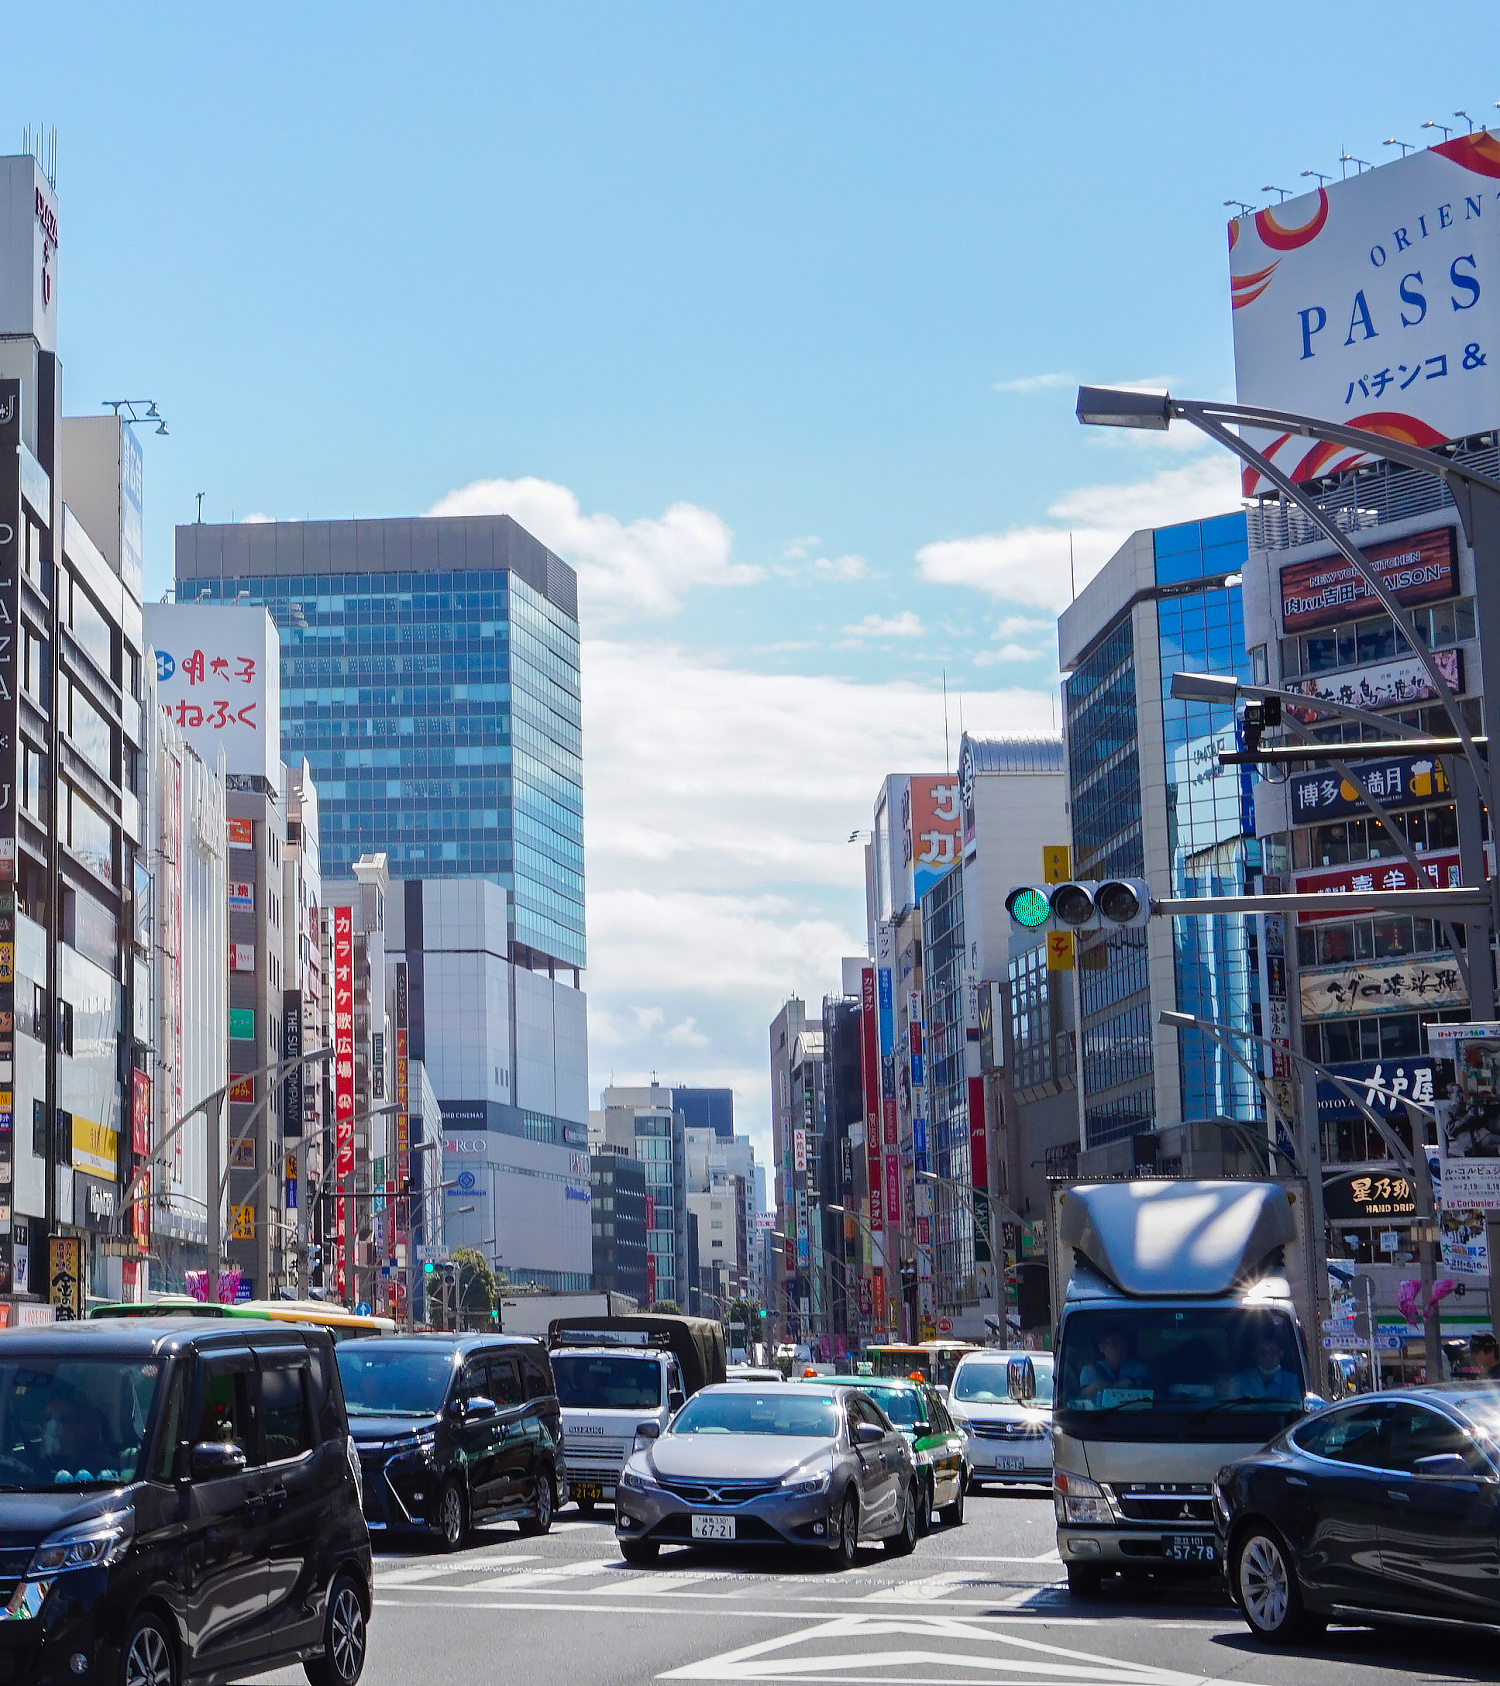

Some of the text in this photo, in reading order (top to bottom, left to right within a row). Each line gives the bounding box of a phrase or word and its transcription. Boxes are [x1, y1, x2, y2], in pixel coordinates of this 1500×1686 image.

[1344, 342, 1488, 404] パチンコ &
[1309, 550, 1421, 589] NEW KITCHEN
[181, 648, 257, 686] 明太子
[878, 925, 890, 961] エッグ
[336, 916, 353, 1078] カラオケ歌広場
[287, 1009, 298, 1033] THE
[1363, 1063, 1438, 1112] 大戸屋
[456, 1111, 485, 1120] CINEMAS
[441, 1138, 488, 1154] PARCO
[1365, 1202, 1415, 1214] HAND DRIP
[1447, 1199, 1494, 1209] Le Corbusier
[568, 1426, 604, 1435] SUZUKI
[576, 1488, 601, 1499] 21-47
[701, 1523, 732, 1538] 67-21
[1173, 1545, 1214, 1561] 57-78
